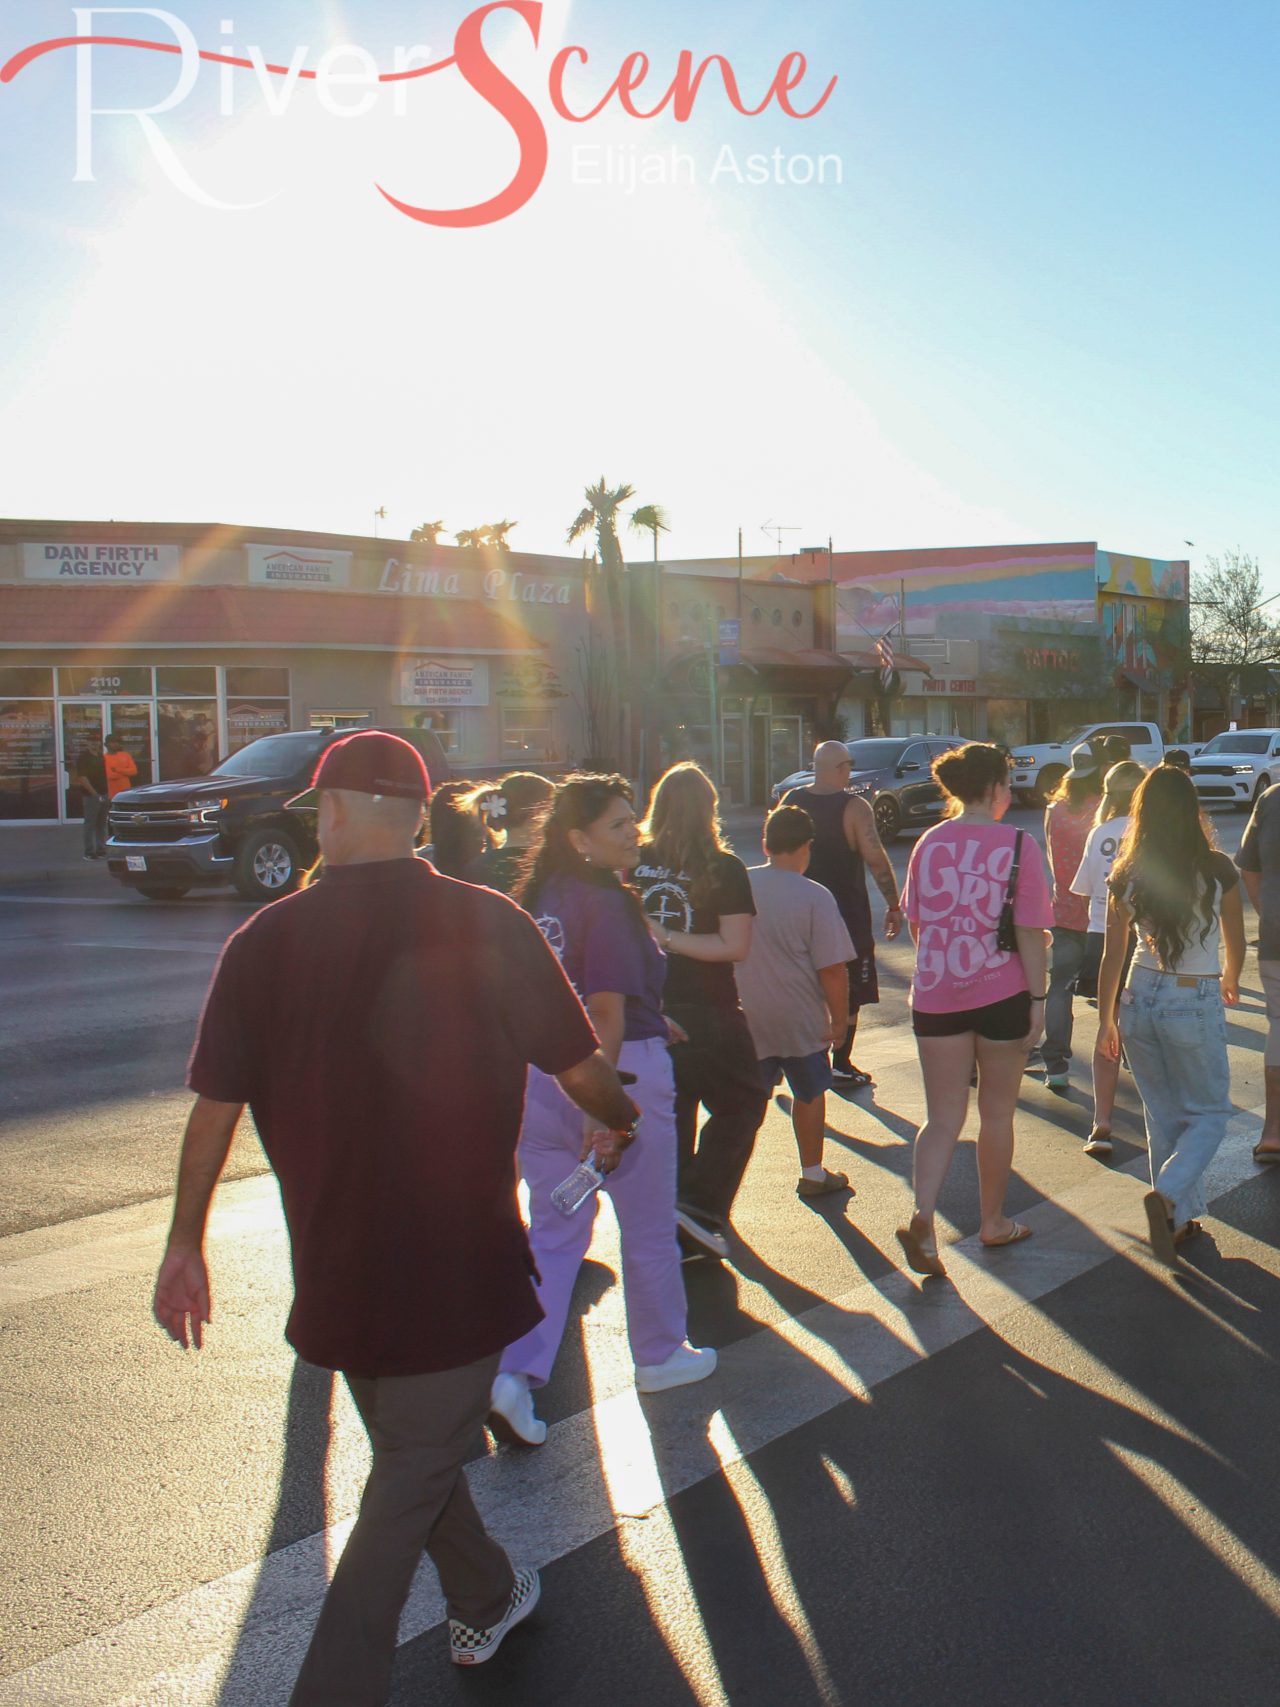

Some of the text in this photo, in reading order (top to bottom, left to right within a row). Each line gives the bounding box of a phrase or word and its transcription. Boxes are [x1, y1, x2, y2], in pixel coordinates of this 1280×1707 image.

[44, 545, 159, 561] DAN FIRTH
[59, 561, 145, 576] AGENCY
[377, 557, 571, 605] Lima Plaza
[91, 676, 121, 687] 2110
[922, 679, 977, 692] PHOTO CENTER
[949, 916, 977, 933] TO
